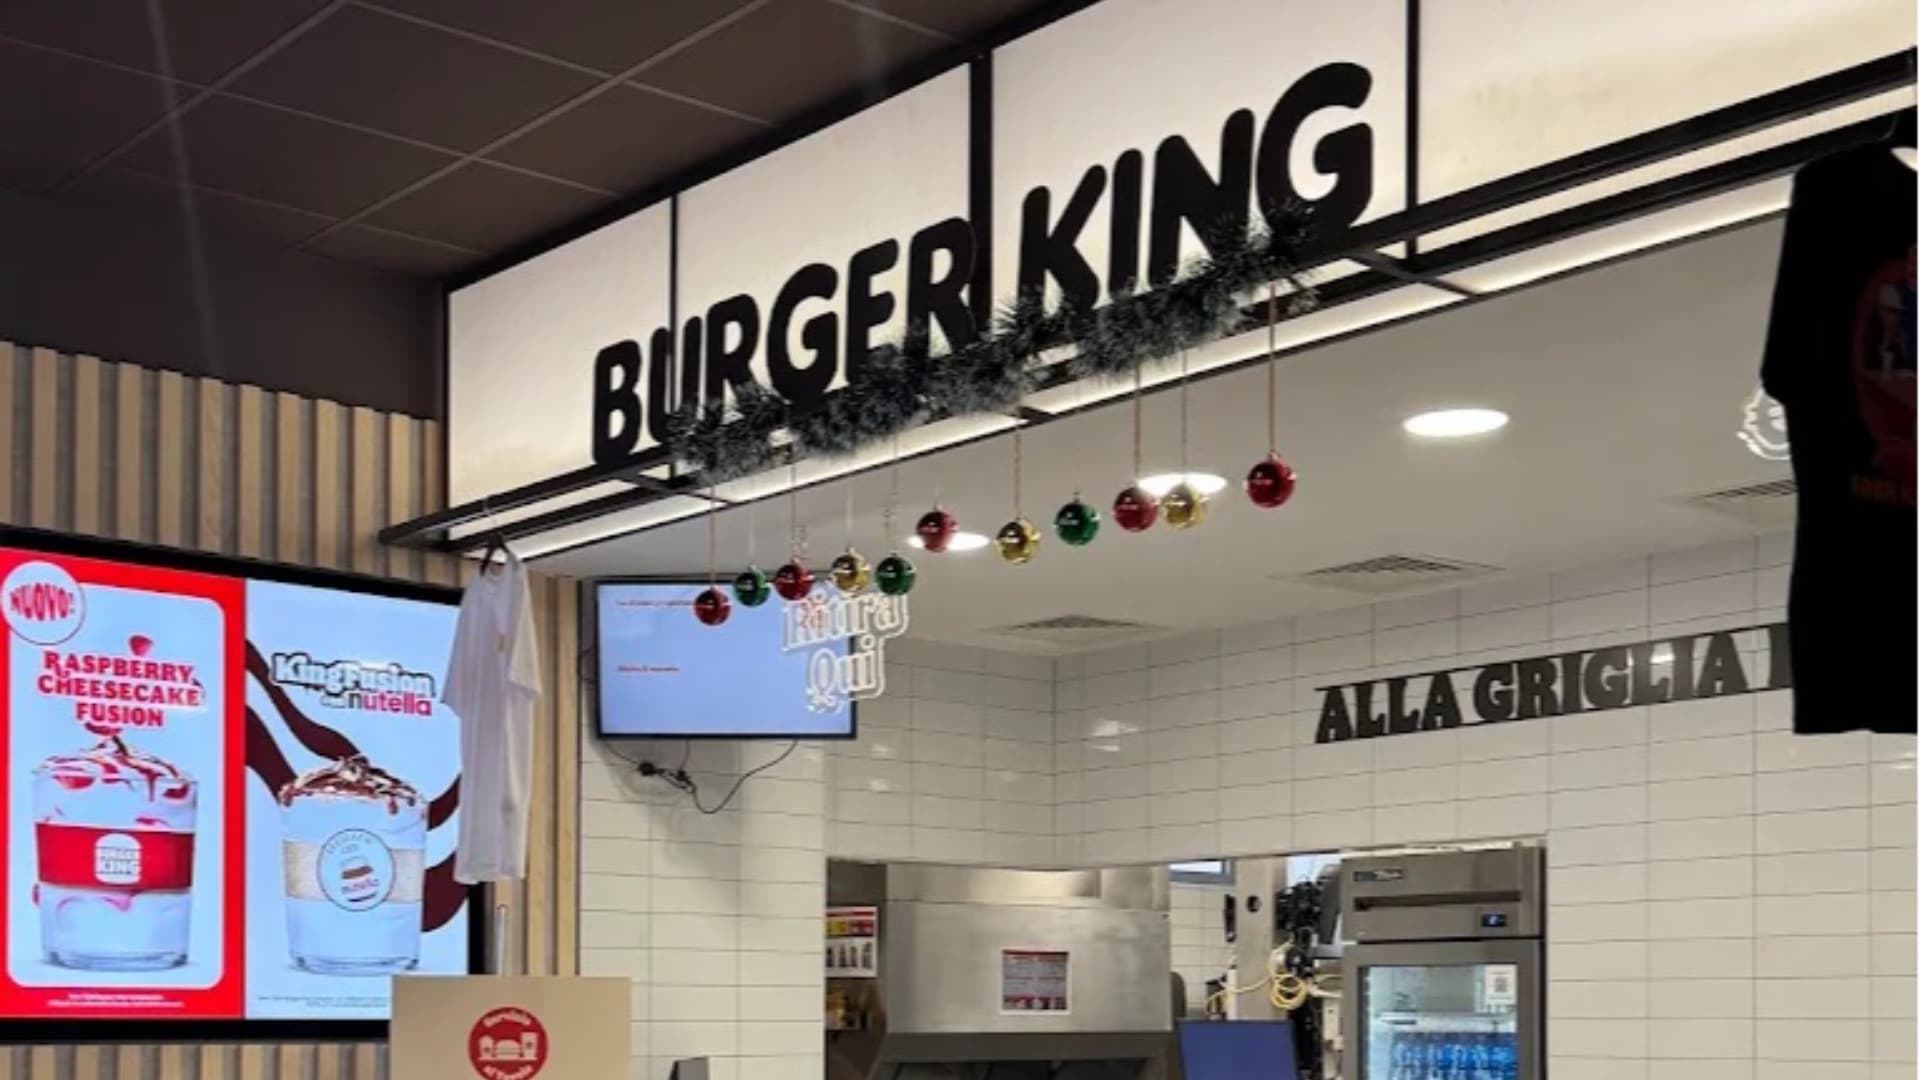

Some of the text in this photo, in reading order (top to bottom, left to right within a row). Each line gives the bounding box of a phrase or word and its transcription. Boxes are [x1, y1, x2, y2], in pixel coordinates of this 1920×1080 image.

[592, 62, 1374, 468] BURGER KING
[9, 582, 76, 621] NUOVO!
[782, 587, 907, 650] Ritira
[44, 651, 194, 683] RASPBERRY
[807, 635, 882, 712] Qui
[38, 675, 200, 706] CHEESECAKE
[348, 691, 432, 716] nutella
[1314, 670, 1462, 744] ALLA
[1472, 632, 1749, 723] GRIGLIA
[76, 702, 163, 726] FUSION
